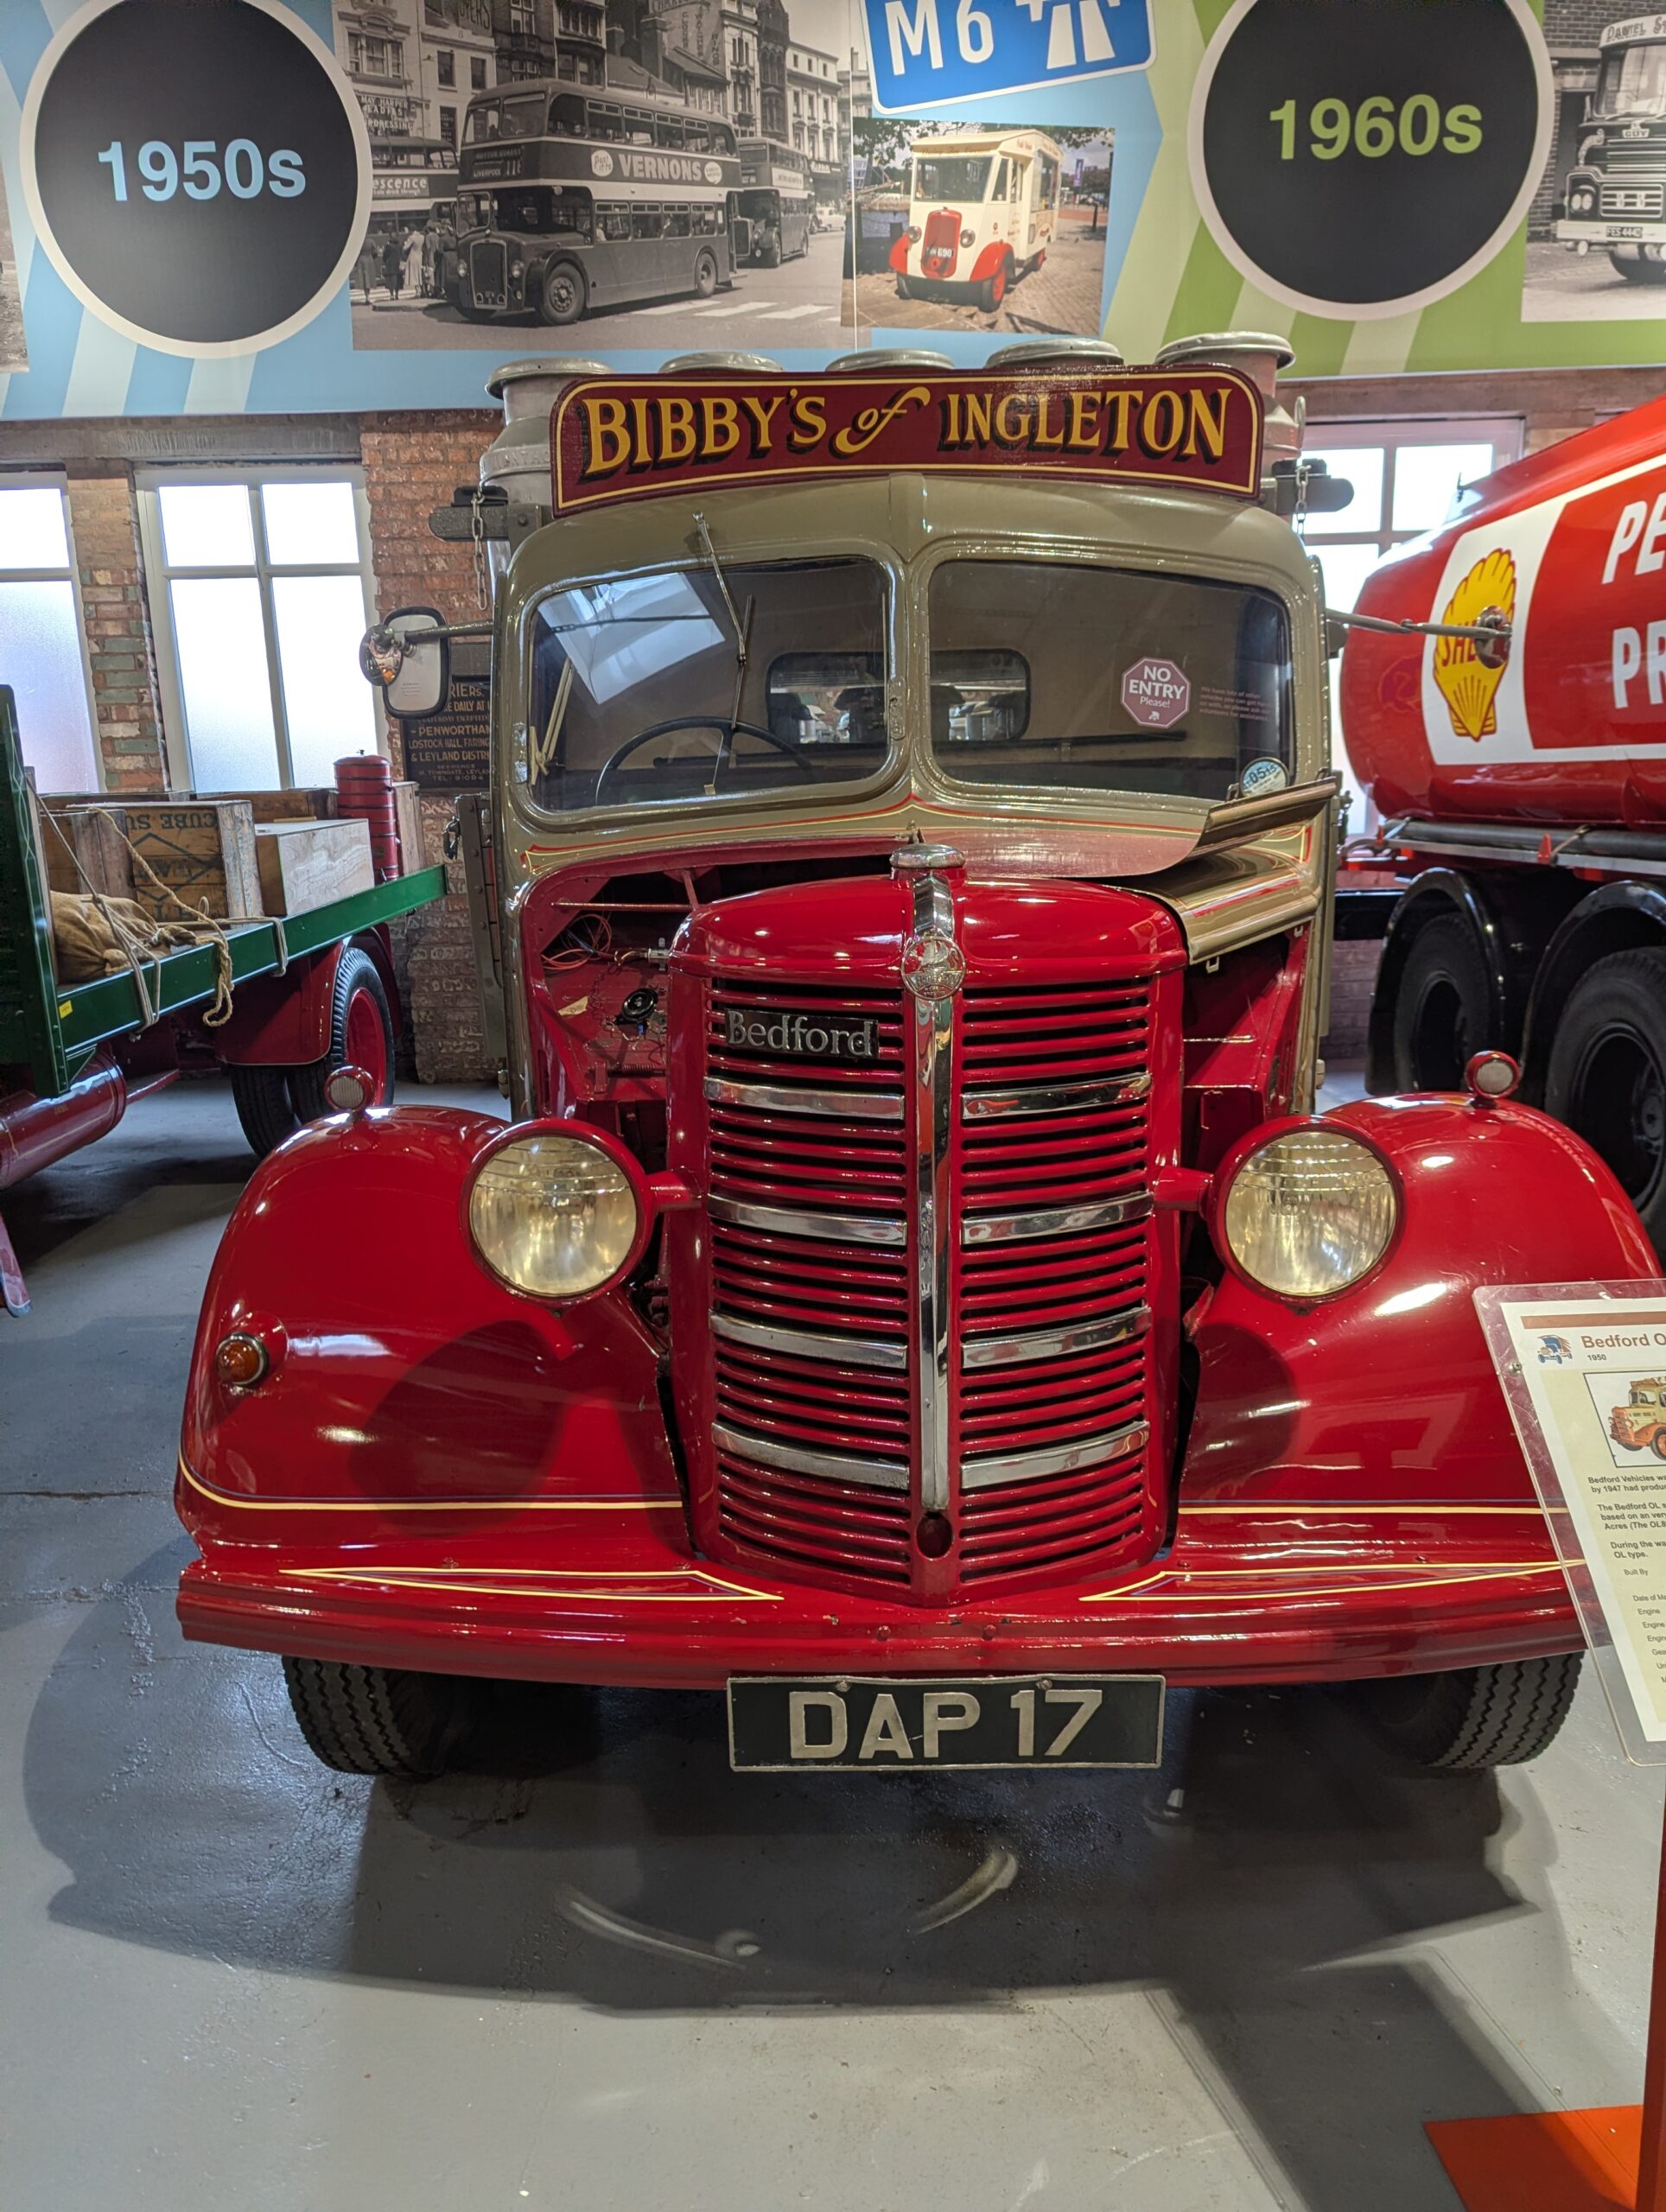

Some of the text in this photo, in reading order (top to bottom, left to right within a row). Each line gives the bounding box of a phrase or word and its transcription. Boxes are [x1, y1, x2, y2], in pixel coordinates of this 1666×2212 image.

[1269, 93, 1483, 160] 1960s
[98, 138, 307, 202] 1950s
[619, 154, 702, 181] VERNONS
[581, 385, 1232, 480] BIBBY'S of INGLETON
[1602, 491, 1666, 584] PE
[1143, 664, 1172, 683] NO
[1129, 679, 1186, 700] ENTRY
[454, 700, 474, 712] DAILY
[476, 700, 486, 711] AT
[1140, 696, 1171, 709] Please!
[408, 740, 444, 750] LOSTOCK
[410, 753, 417, 762] &
[419, 750, 460, 761] LEYLAND
[160, 812, 217, 830] CUBE
[726, 1009, 873, 1057] Bedford
[1580, 1333, 1650, 1348] Bedford
[1621, 1474, 1655, 1483] Vehicles
[1630, 1521, 1648, 1530] (The
[789, 1688, 1103, 1759] DAP 17
